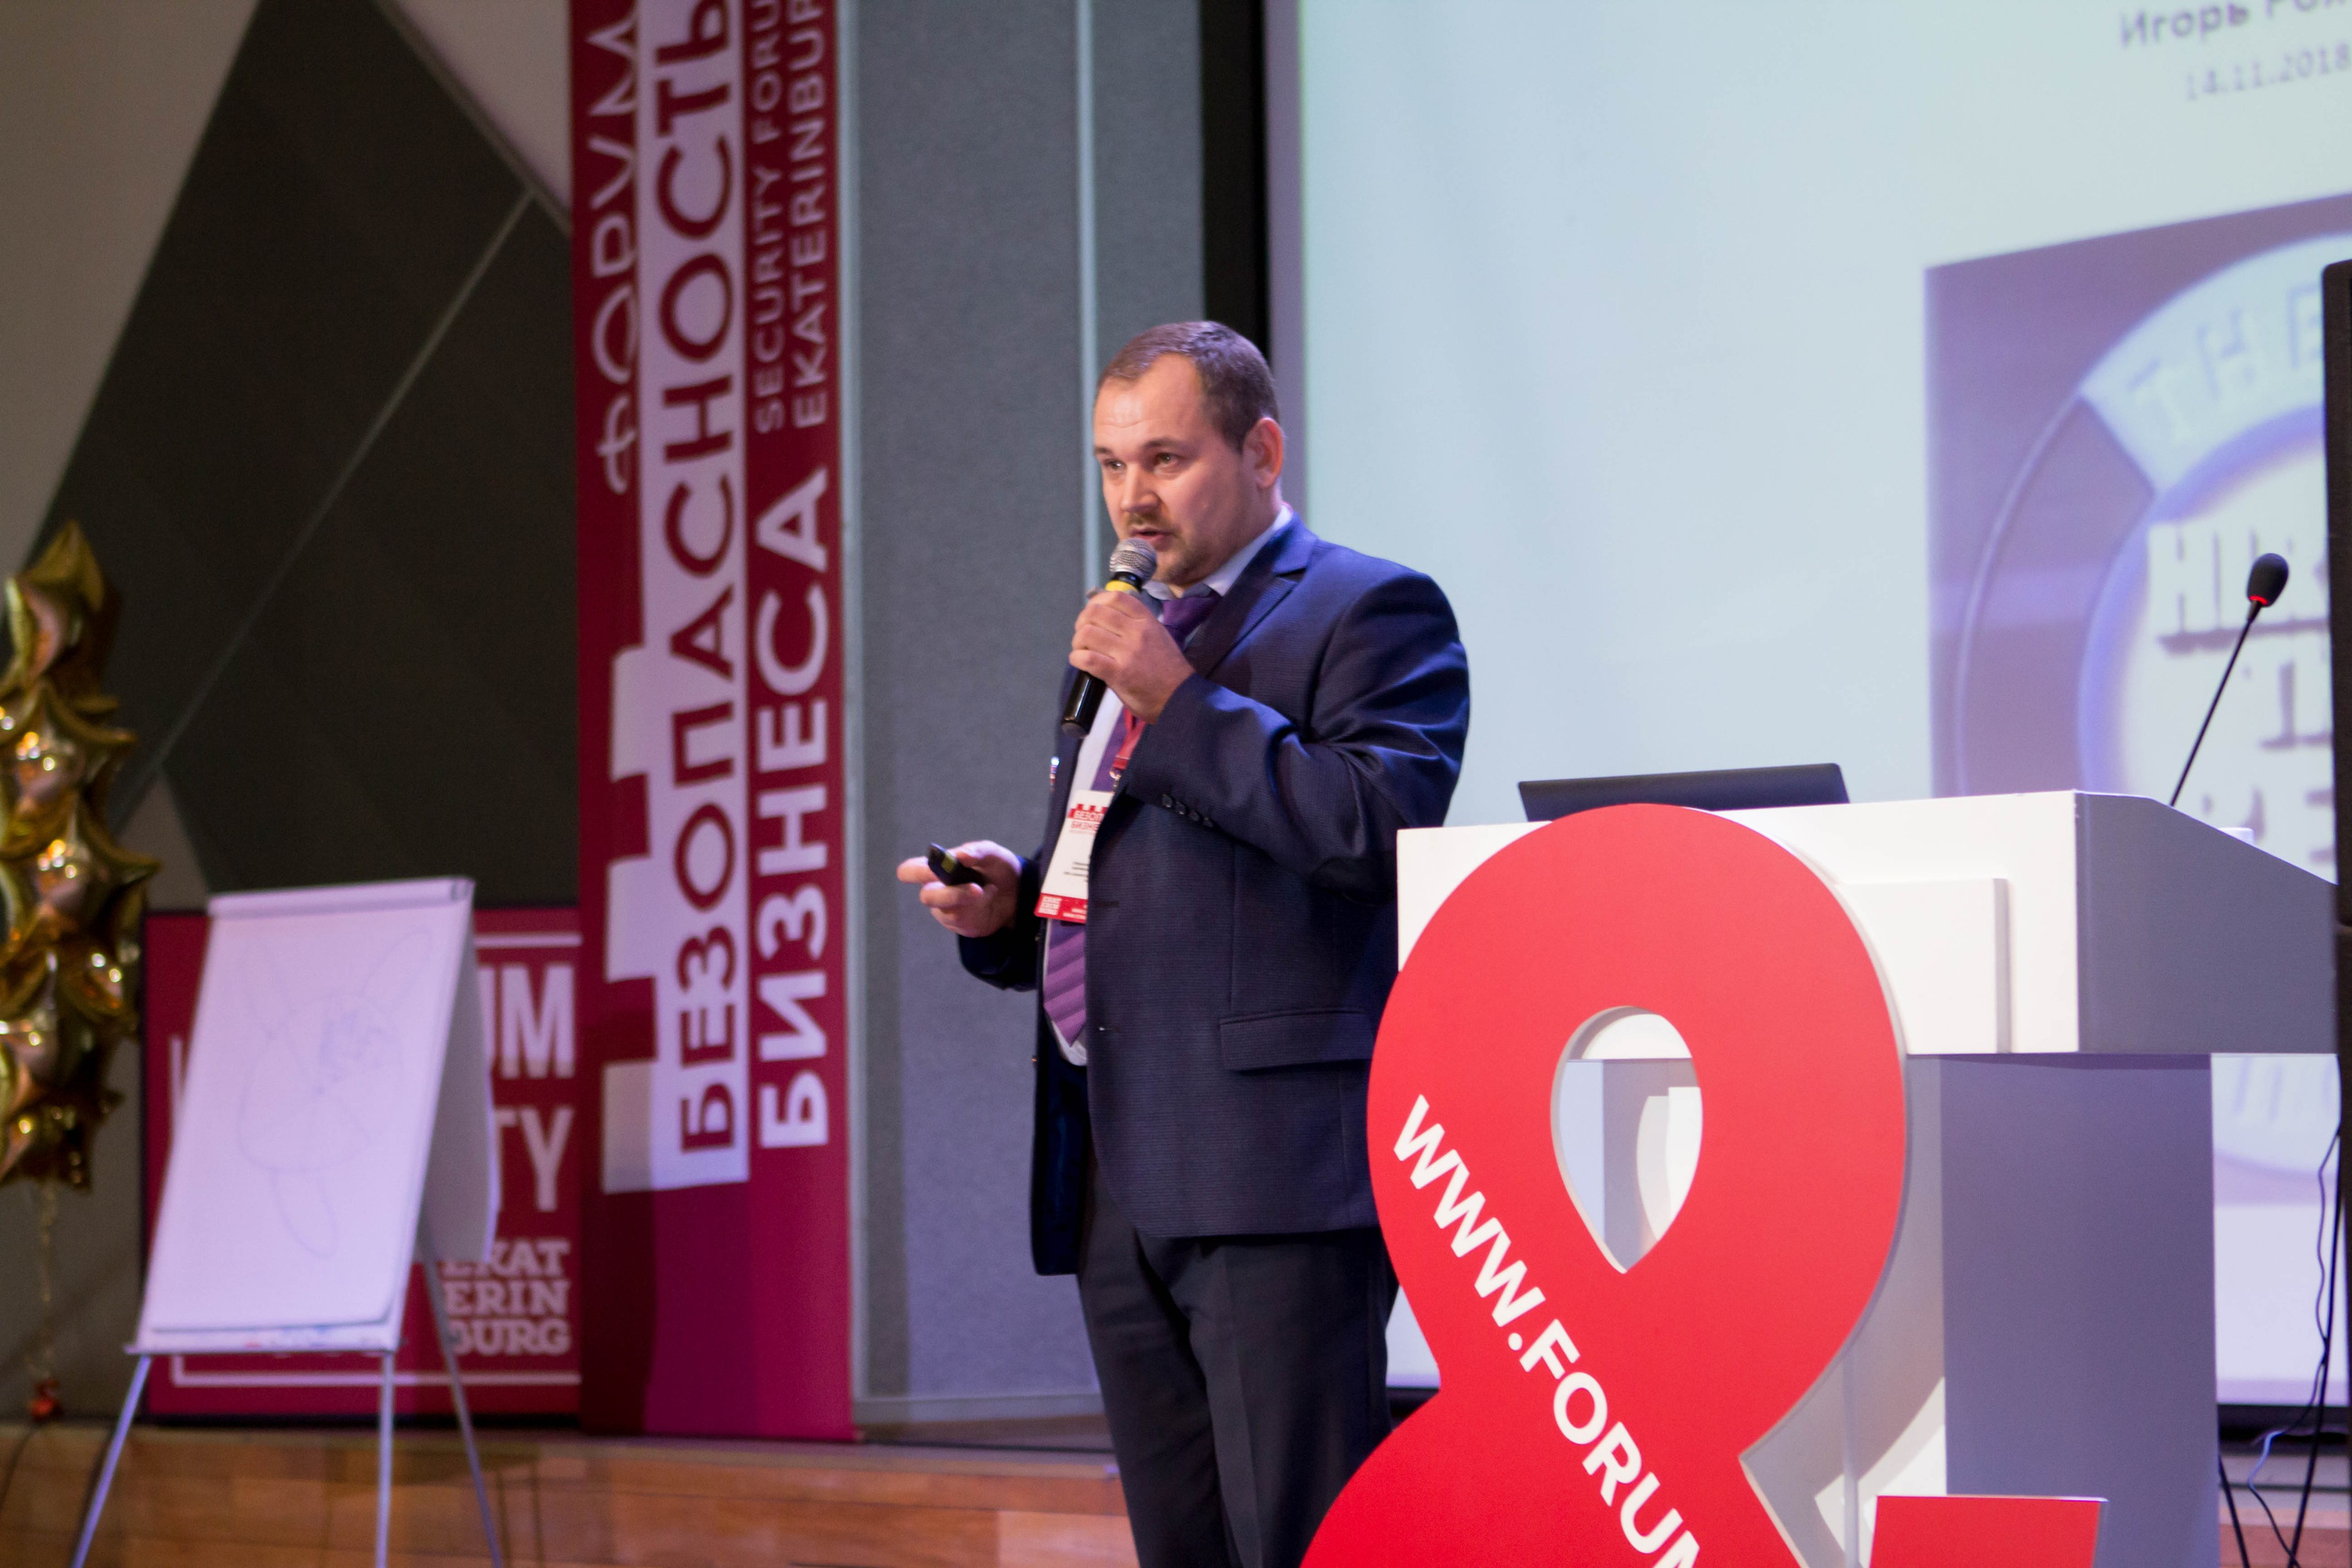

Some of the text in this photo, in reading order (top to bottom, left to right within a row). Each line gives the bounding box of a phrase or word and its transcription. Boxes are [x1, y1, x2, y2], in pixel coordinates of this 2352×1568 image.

[2119, 3, 2251, 49] Игорь
[752, 164, 786, 434] SECURITY
[654, 0, 734, 1154] БЕЗОПАСНОСТЬ
[755, 466, 828, 1149] БИЗНЕСА
[443, 1280, 571, 1315] ERIN
